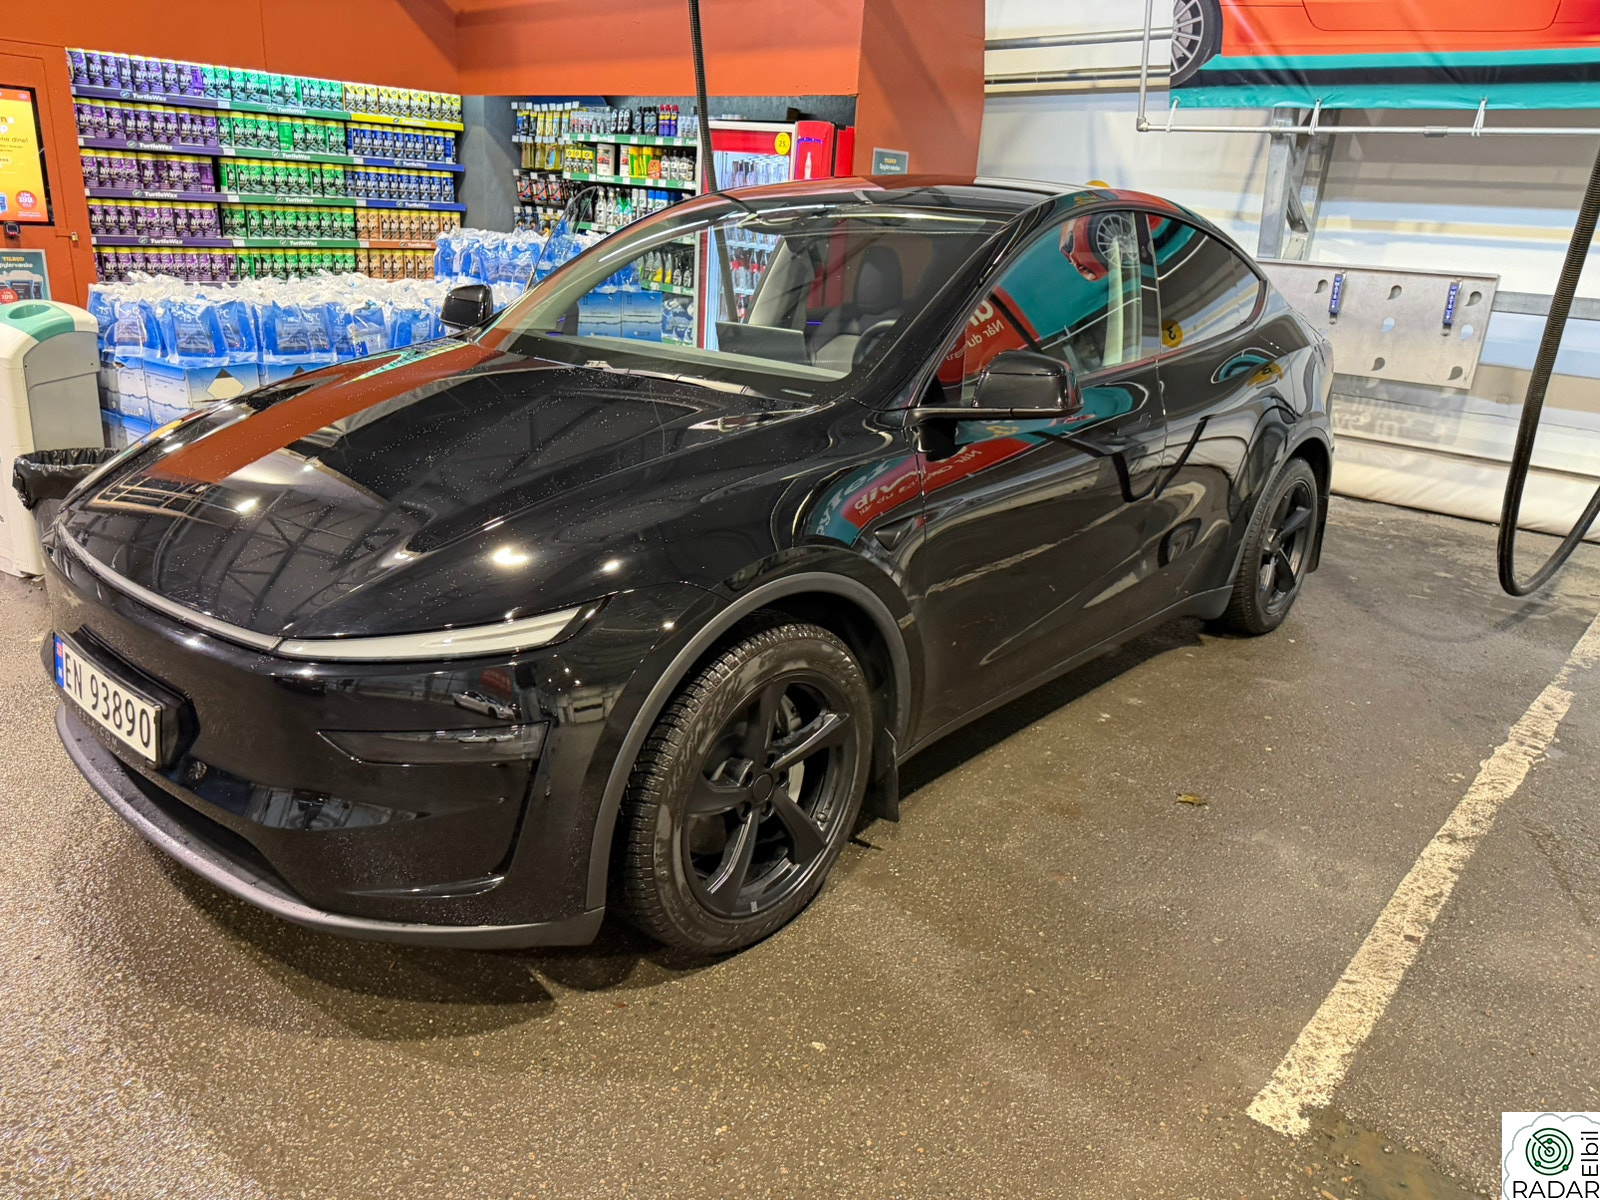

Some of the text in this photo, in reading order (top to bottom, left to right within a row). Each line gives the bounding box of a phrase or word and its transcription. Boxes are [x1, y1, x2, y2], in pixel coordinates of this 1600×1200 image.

[132, 92, 167, 101] TurtleWax
[277, 106, 306, 115] TurtleWax
[139, 142, 173, 151] TurtleWax
[281, 153, 311, 161] TurtleWax
[144, 191, 178, 199] TurtleWax
[150, 238, 183, 246] TurtleWax
[64, 651, 151, 749] EN 93890
